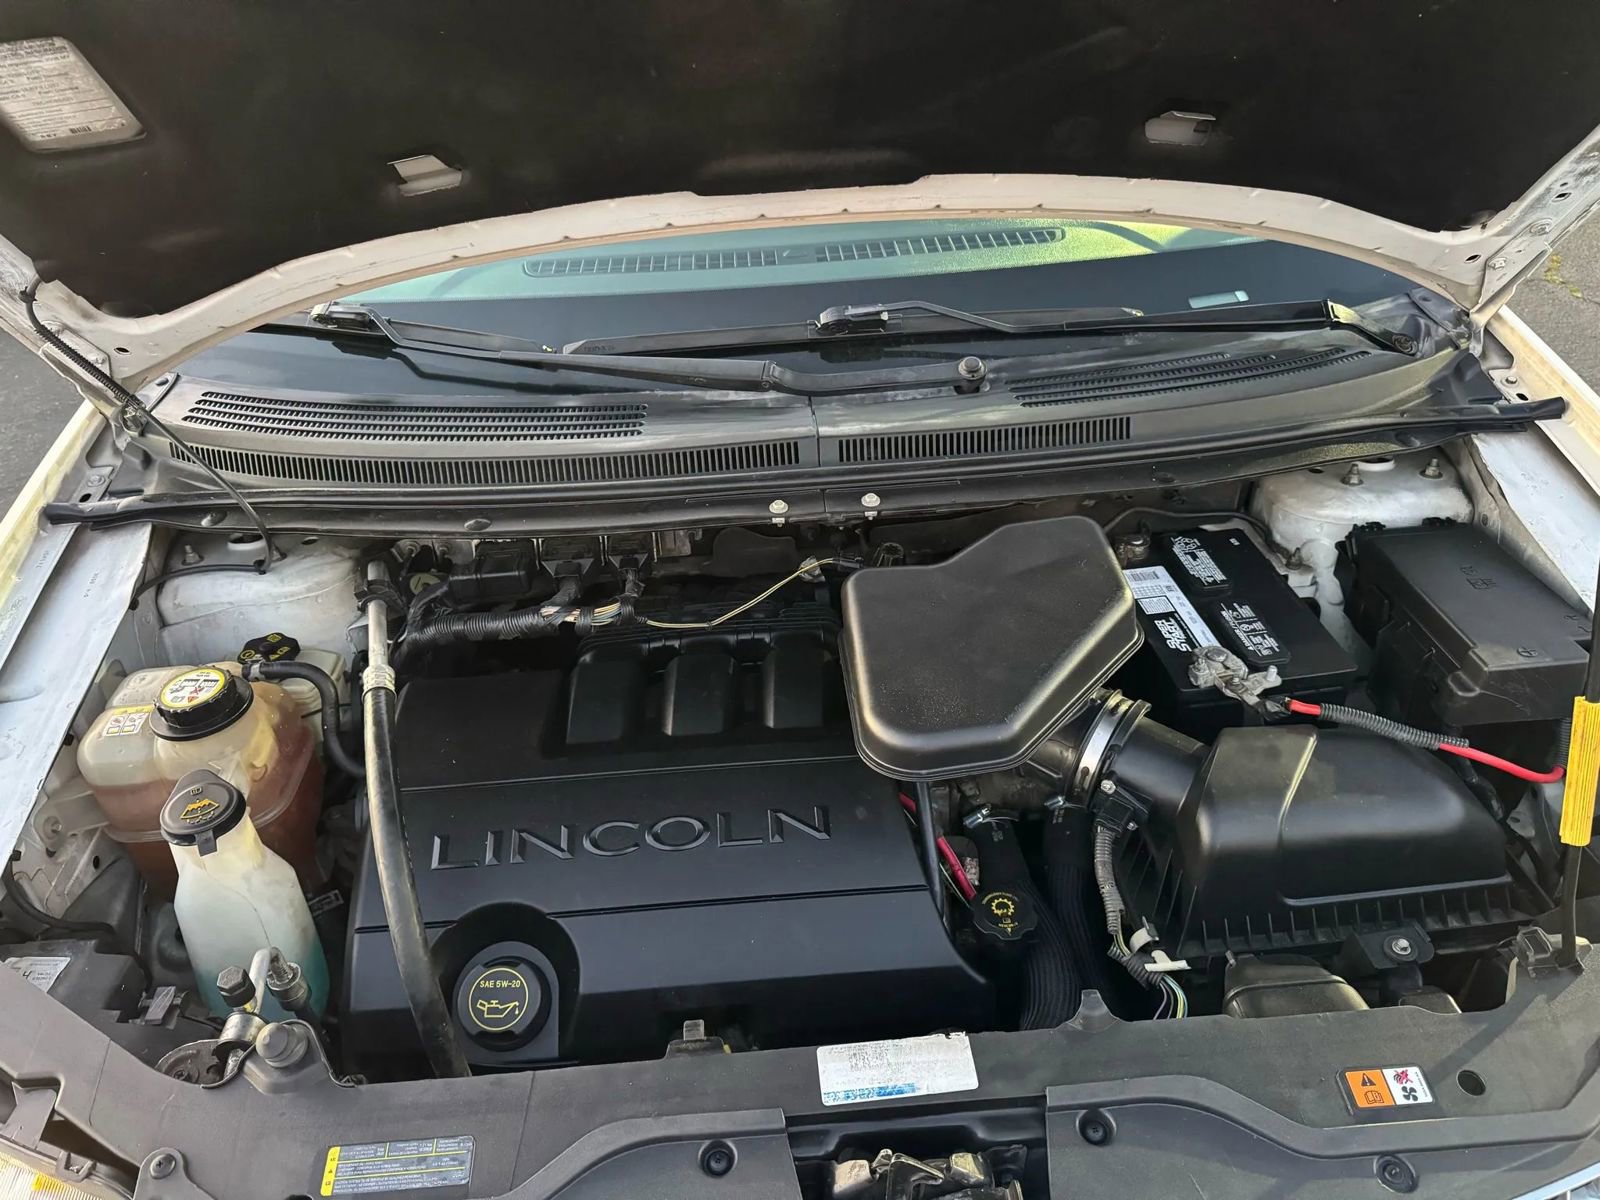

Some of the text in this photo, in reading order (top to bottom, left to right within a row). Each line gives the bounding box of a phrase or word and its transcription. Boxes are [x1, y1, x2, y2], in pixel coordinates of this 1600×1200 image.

[1154, 619, 1177, 649] SUPER
[1168, 616, 1193, 652] START
[431, 805, 831, 870] LINCOLN
[480, 980, 521, 988] SAE 5W-20
